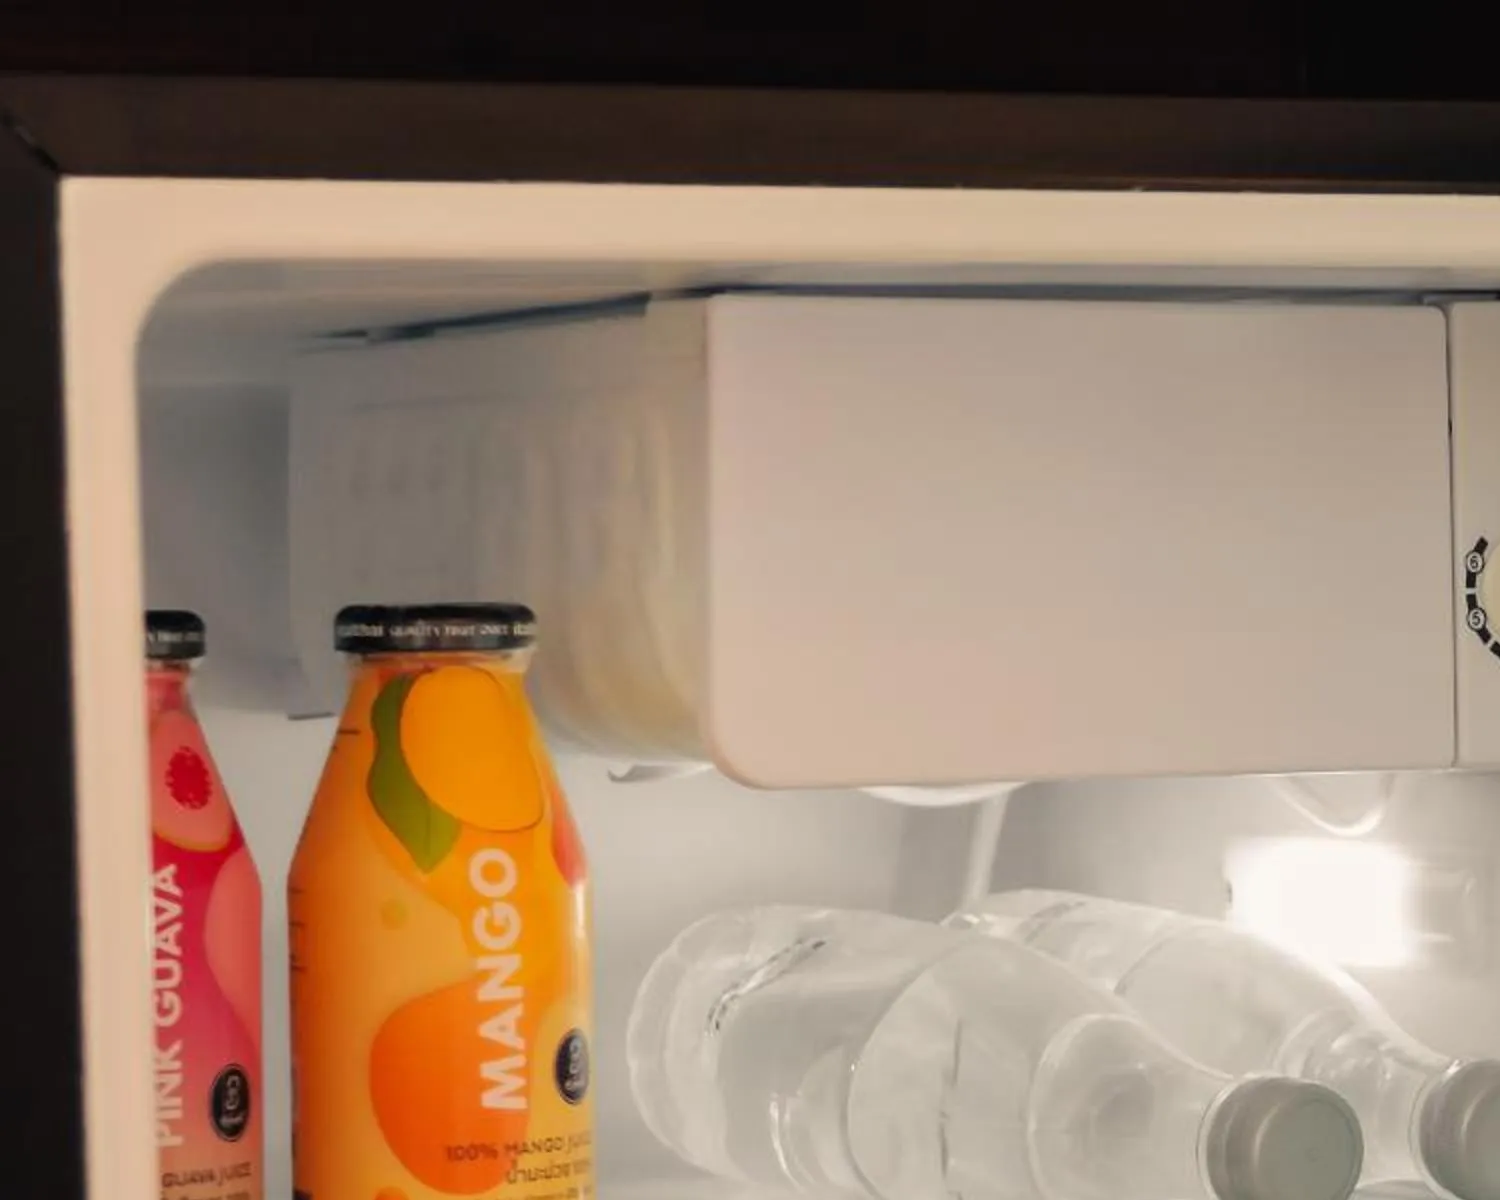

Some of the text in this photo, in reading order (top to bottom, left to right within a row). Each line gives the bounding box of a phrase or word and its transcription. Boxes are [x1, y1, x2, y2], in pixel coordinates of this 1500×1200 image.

[151, 863, 184, 1028] GUAVA
[467, 847, 529, 1111] MANGO
[446, 1142, 500, 1162] 100%
[503, 1135, 564, 1157] MANGO
